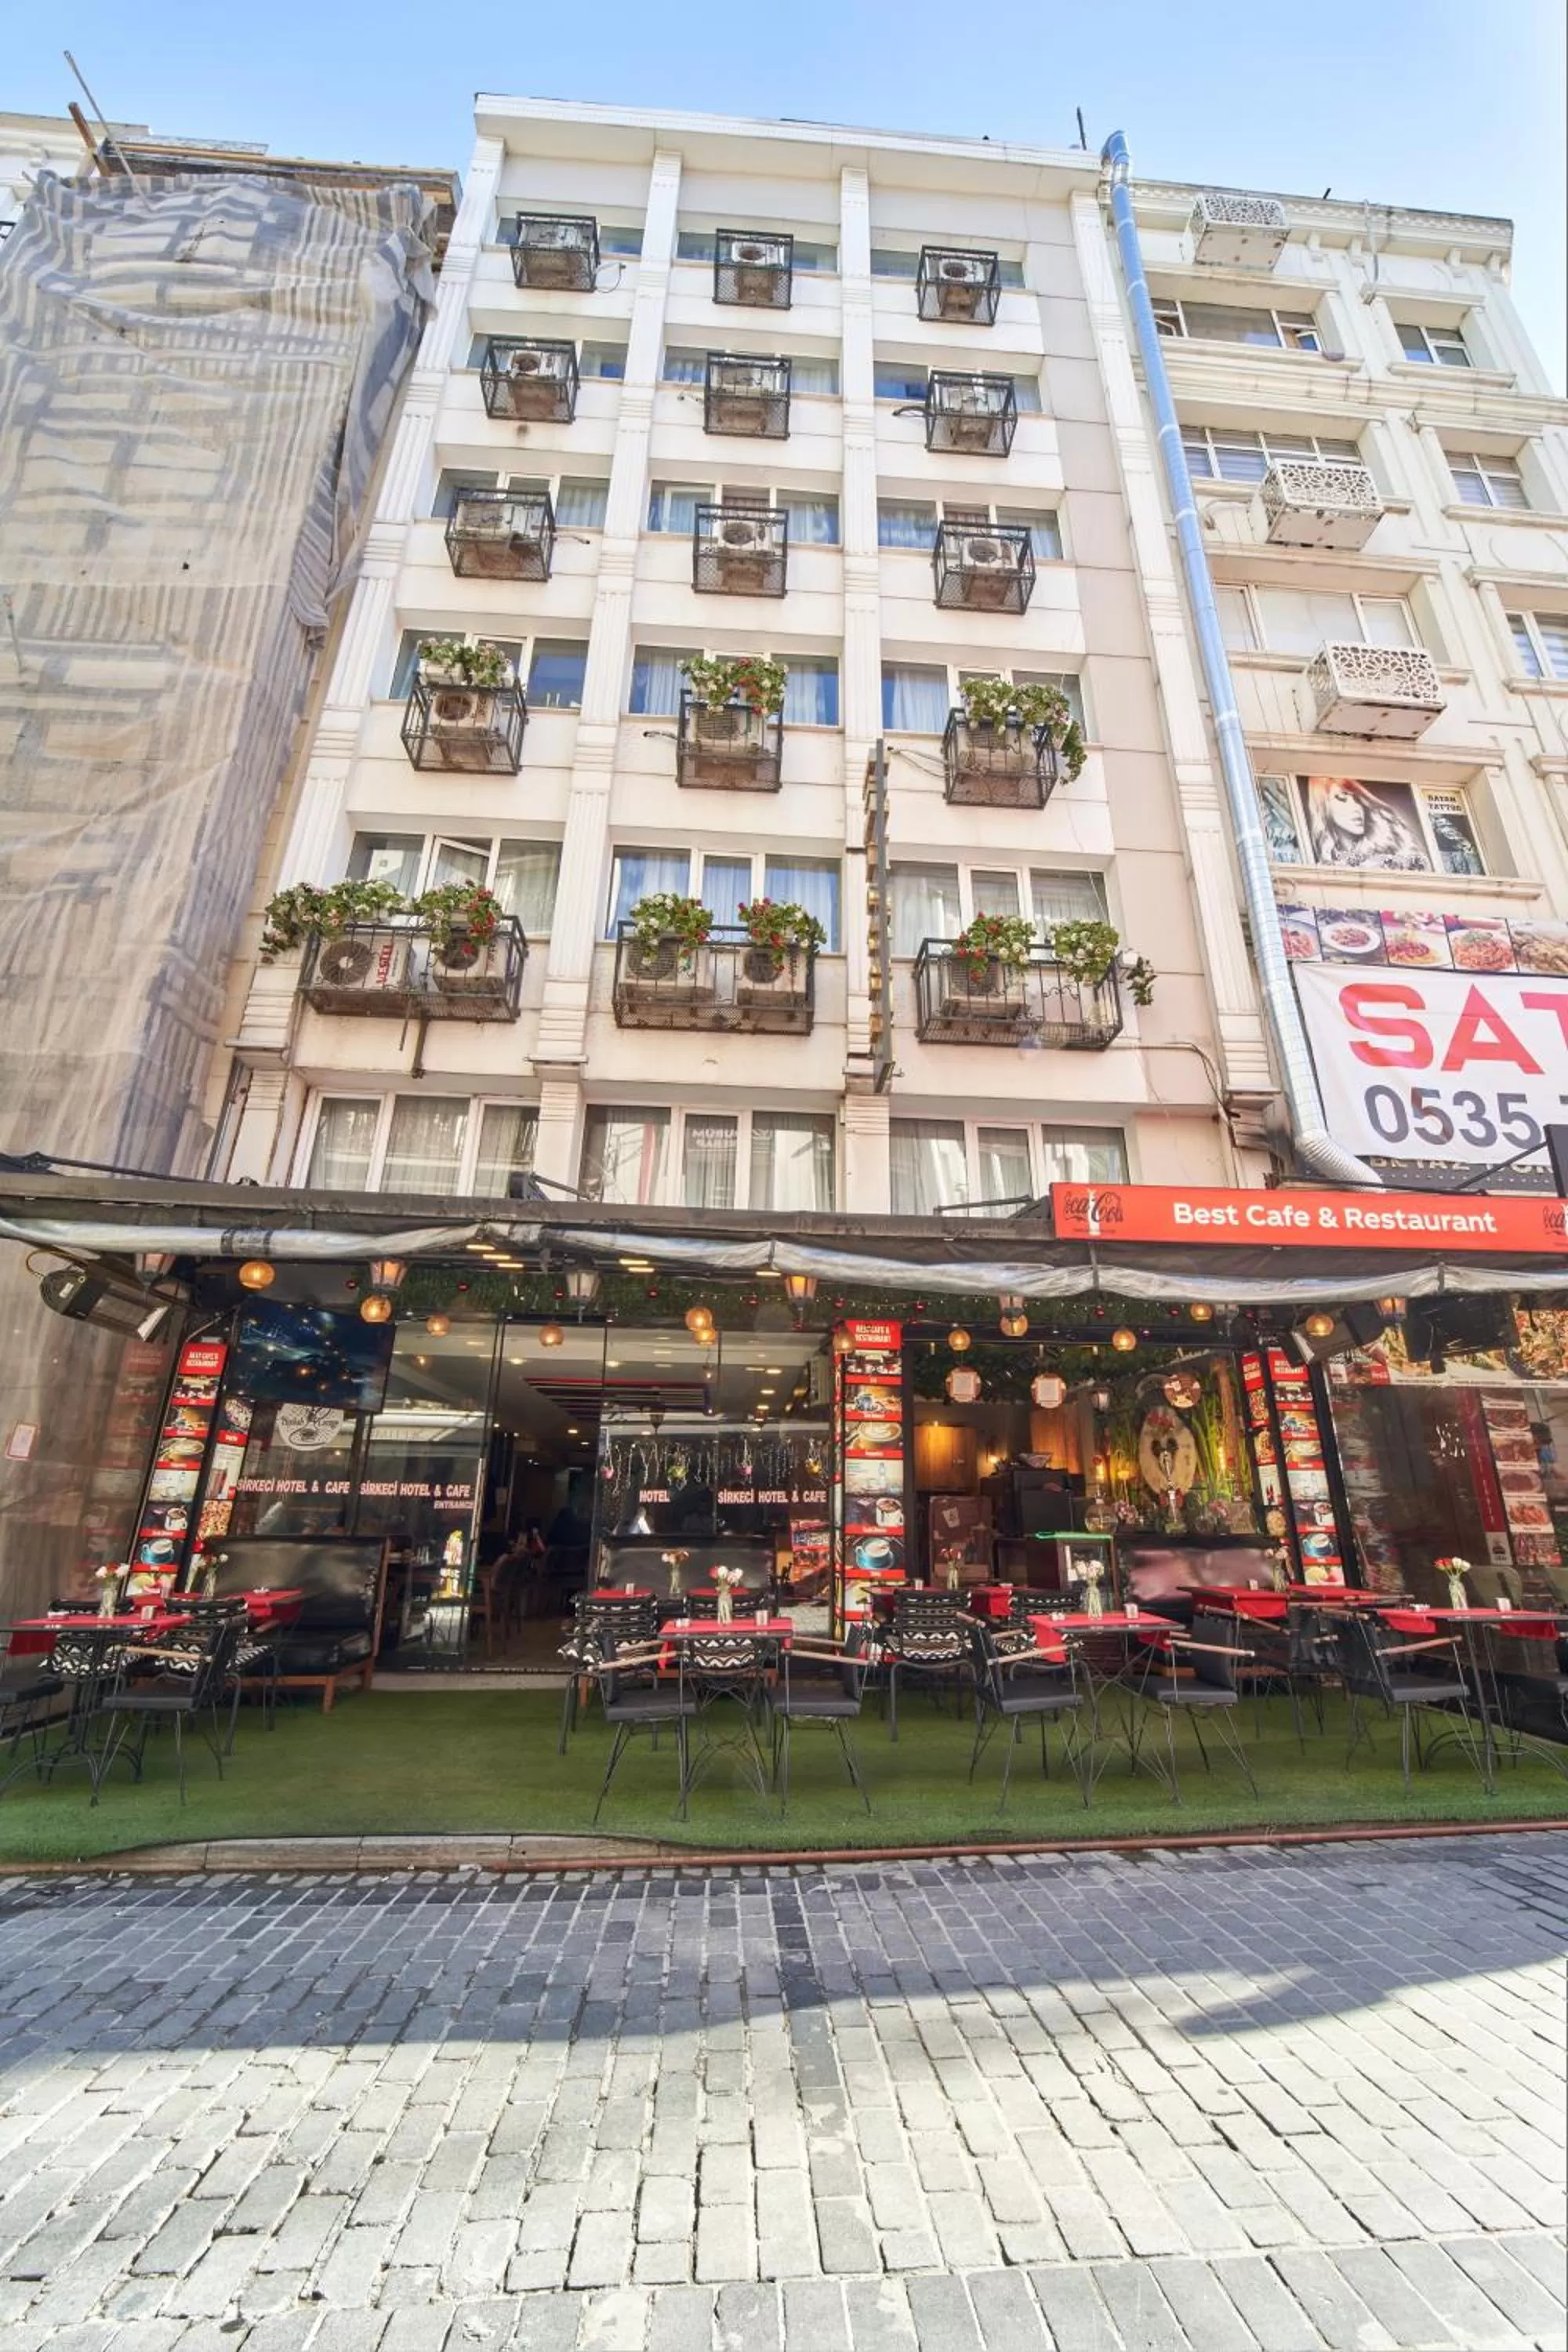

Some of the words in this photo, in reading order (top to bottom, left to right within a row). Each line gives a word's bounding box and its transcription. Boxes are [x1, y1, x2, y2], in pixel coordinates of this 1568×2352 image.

[1364, 1084, 1542, 1149] 0535
[1173, 1202, 1240, 1225] Best
[1246, 1204, 1311, 1228] Cafe
[1318, 1207, 1339, 1229] &
[1345, 1207, 1497, 1232] Restaurant
[276, 1479, 307, 1494] HOTEL
[311, 1479, 319, 1493] &
[325, 1481, 351, 1494] CAFE
[399, 1482, 431, 1497] HOTEL
[434, 1483, 441, 1497] &
[446, 1484, 471, 1497] CAFE
[639, 1490, 670, 1503] HOTEL
[757, 1490, 789, 1503] HOTEL
[791, 1490, 800, 1503] &
[802, 1490, 827, 1503] CAFE
